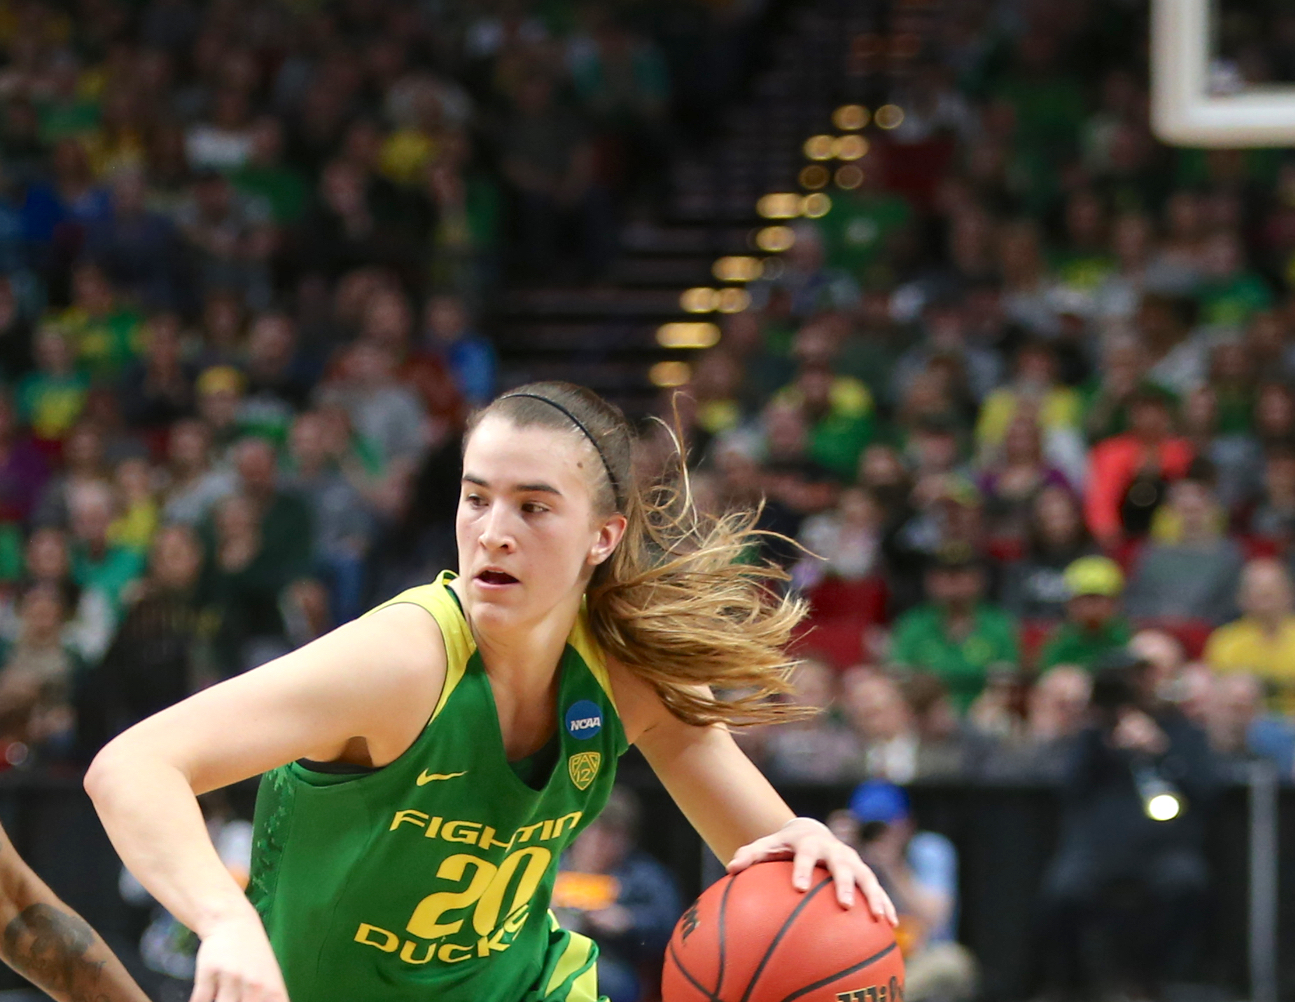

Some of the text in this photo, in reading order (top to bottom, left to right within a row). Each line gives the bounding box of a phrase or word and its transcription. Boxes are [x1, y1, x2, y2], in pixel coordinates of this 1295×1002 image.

[571, 717, 601, 731] NCAA
[571, 755, 598, 776] PAC
[576, 768, 592, 782] 12
[405, 846, 552, 939] 20
